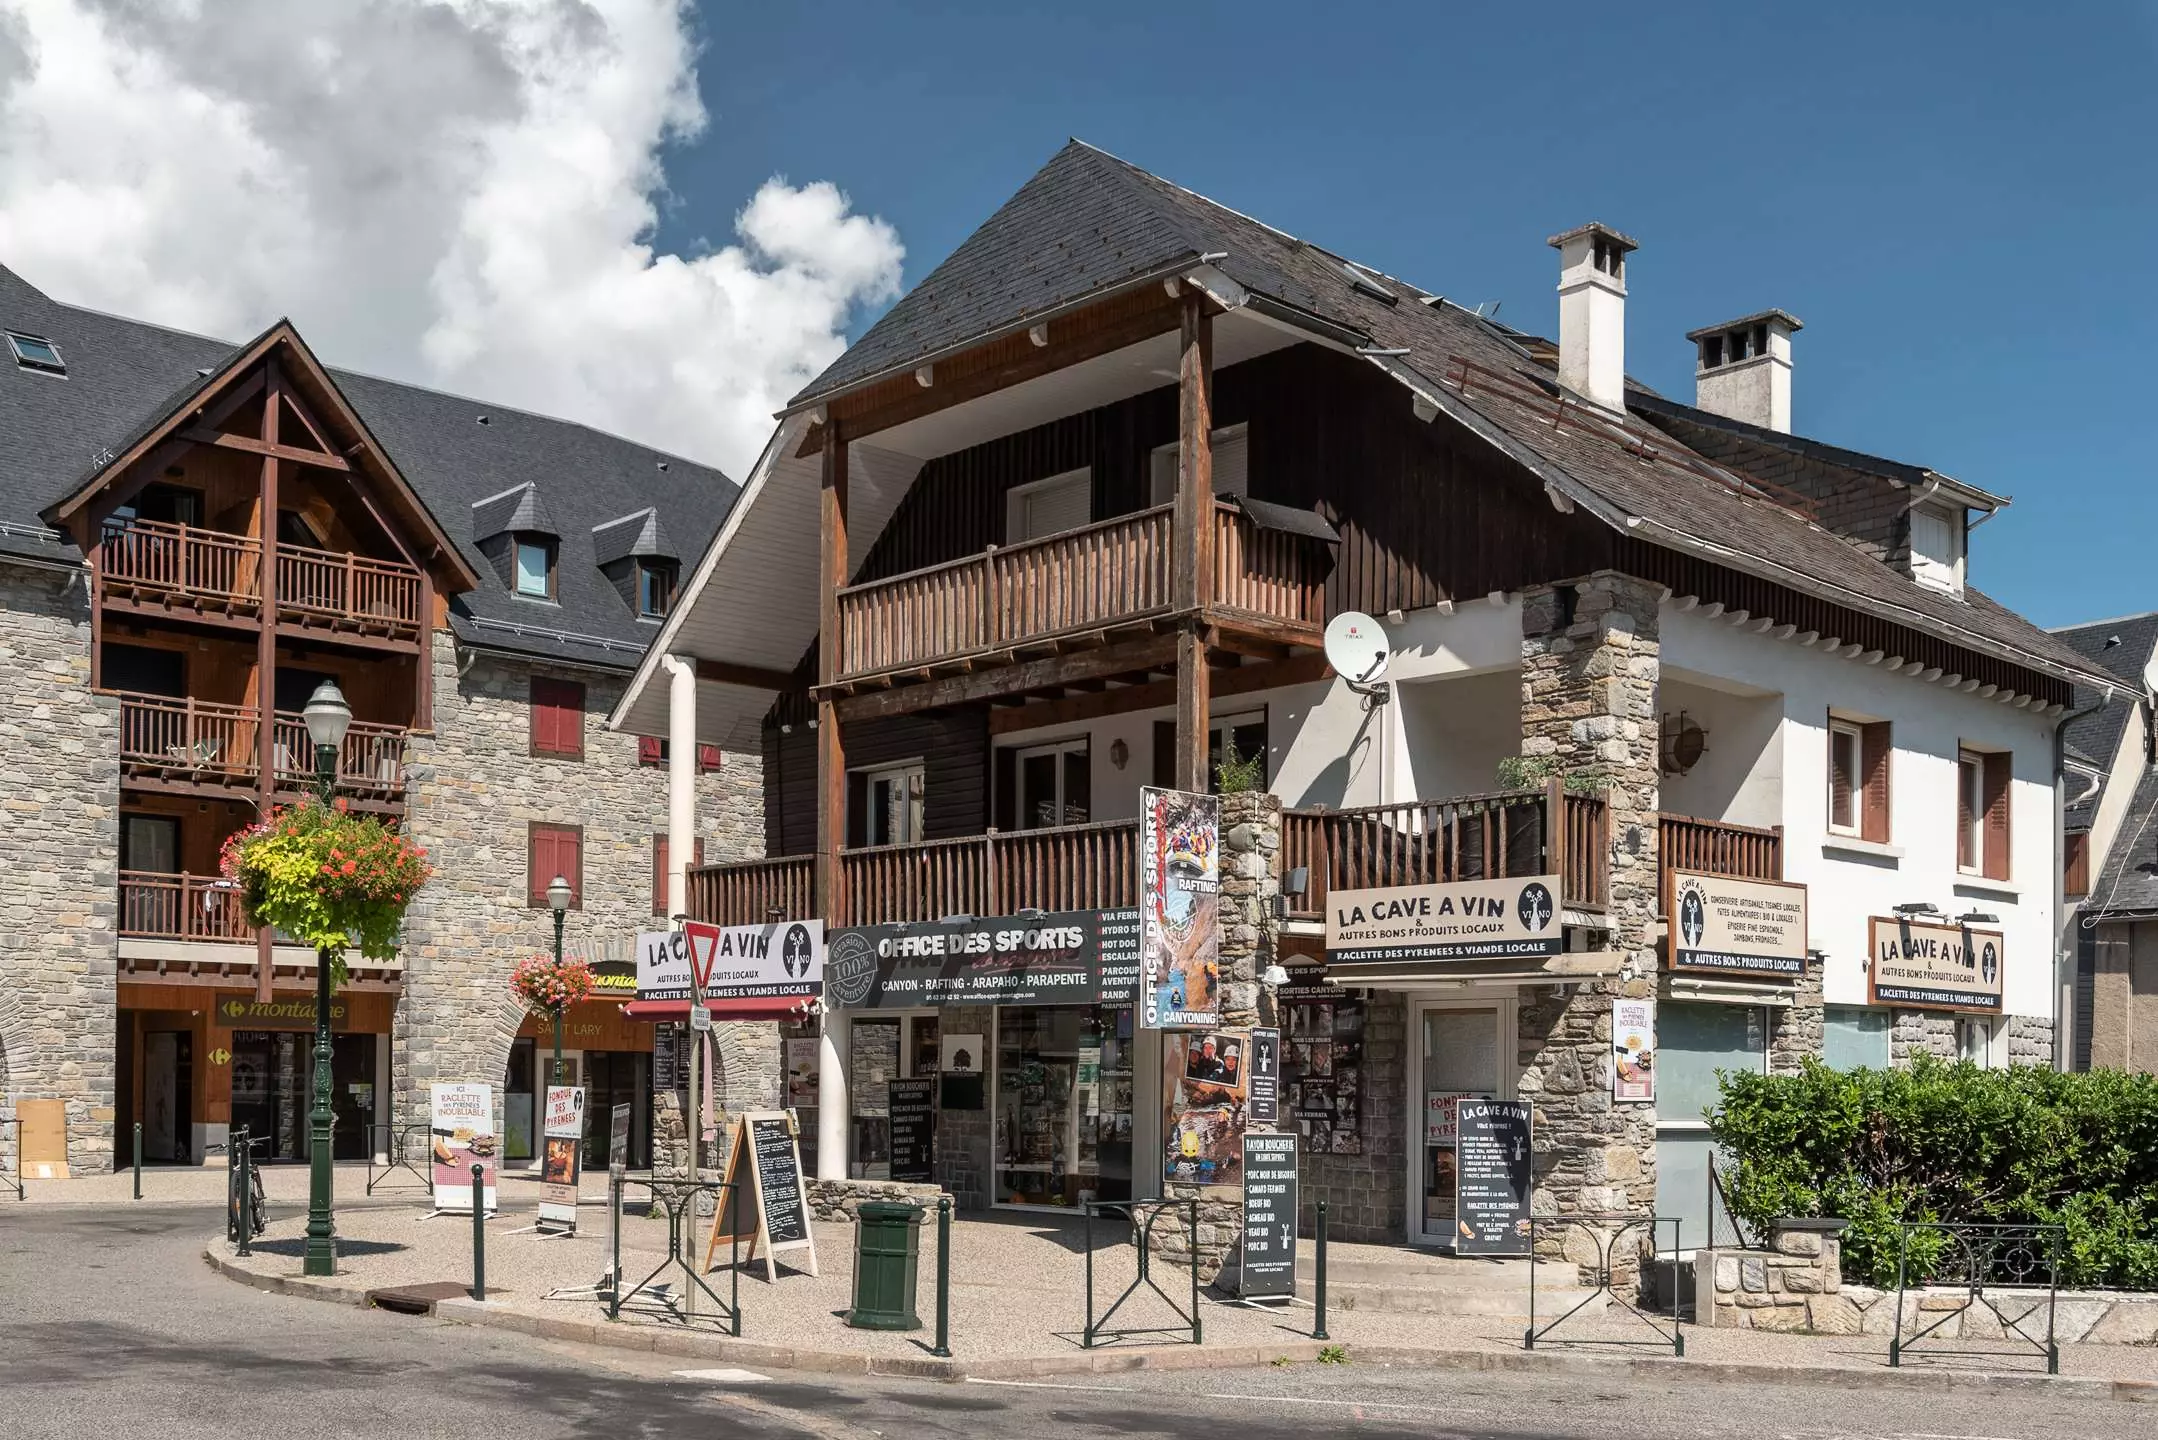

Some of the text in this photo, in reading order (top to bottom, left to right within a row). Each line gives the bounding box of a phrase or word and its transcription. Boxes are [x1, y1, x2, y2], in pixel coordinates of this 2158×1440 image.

[1179, 879, 1216, 893] RAFTING
[1146, 792, 1158, 1024] OFFICE DES SPORTS
[1338, 896, 1504, 928] LA CAVE A VIN
[1102, 912, 1115, 920] VIA
[1102, 926, 1129, 935] HYDRO
[1339, 924, 1504, 940] AUTRES BONS PRODUITS LOCAUX
[878, 926, 1083, 958] OFFICE DES SPORTS
[1102, 939, 1136, 949] HOT DOG
[649, 942, 668, 967] LA
[721, 933, 732, 956] A
[738, 933, 769, 960] VIN
[1337, 943, 1546, 960] RACLETTE DES PYRENEES & VIANDE LOCALE
[1882, 938, 1975, 970] LA CAVE A VIN
[1695, 954, 1722, 966] AUTRES
[1723, 956, 1741, 968] BONS
[1742, 958, 1773, 969] PRODUITS
[1774, 960, 1799, 971] LOCAUX
[657, 971, 759, 984] AUTRES LOCAUX
[882, 973, 1087, 991] CANYON RAFTING ARAPAHO PARAPENTE
[1882, 967, 1976, 983] AUTRES BONS PRODUITS LOCAUX
[645, 985, 811, 1000] RACLETTE & VIANDE LOCALE
[1102, 990, 1130, 999] RANDO
[1880, 988, 1909, 999] RACLETTE
[1910, 991, 1920, 1000] DES
[1921, 992, 1949, 1002] PYRENEES
[1955, 994, 1974, 1004] VIANDE
[1975, 996, 1994, 1006] LOCALE
[1163, 1012, 1216, 1024] CANYONING
[537, 1024, 602, 1035] SAIT LARY
[441, 1094, 480, 1102] RACLETTE
[439, 1108, 486, 1118] INOUBLIABLE
[1462, 1106, 1527, 1120] LA CAVE A VIN
[1265, 1139, 1294, 1150] BOUCHERIE
